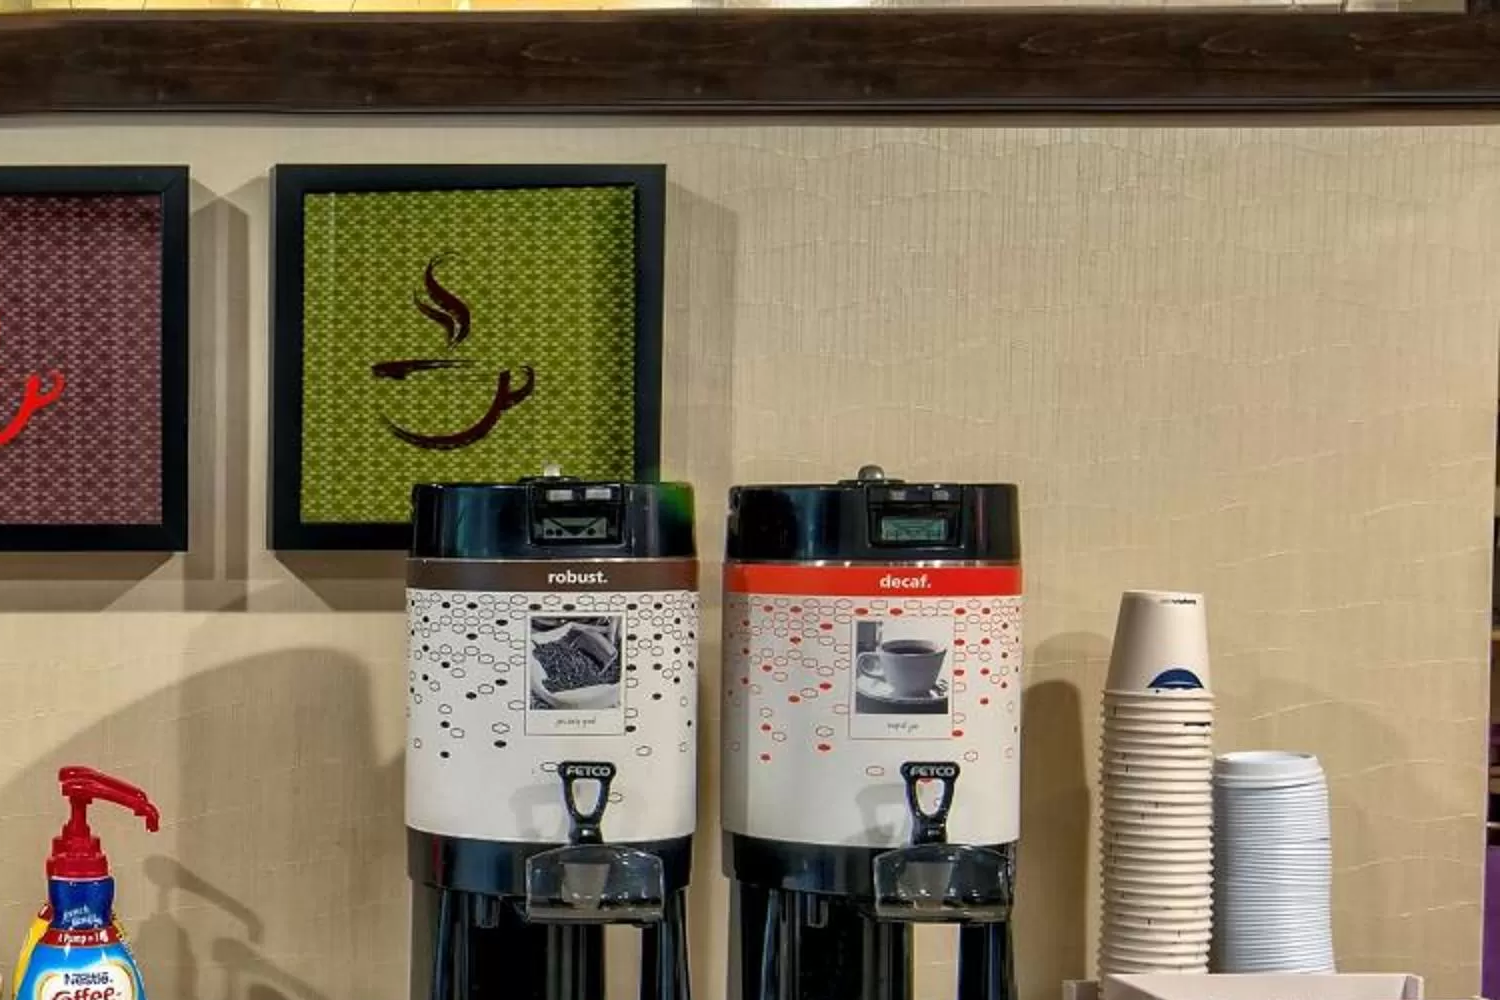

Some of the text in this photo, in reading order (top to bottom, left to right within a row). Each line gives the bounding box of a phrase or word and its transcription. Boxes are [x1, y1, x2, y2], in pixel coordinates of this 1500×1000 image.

[547, 569, 609, 585] robust.
[879, 573, 932, 589] decaf.
[566, 765, 611, 777] FETCO
[909, 765, 956, 777] FETCO
